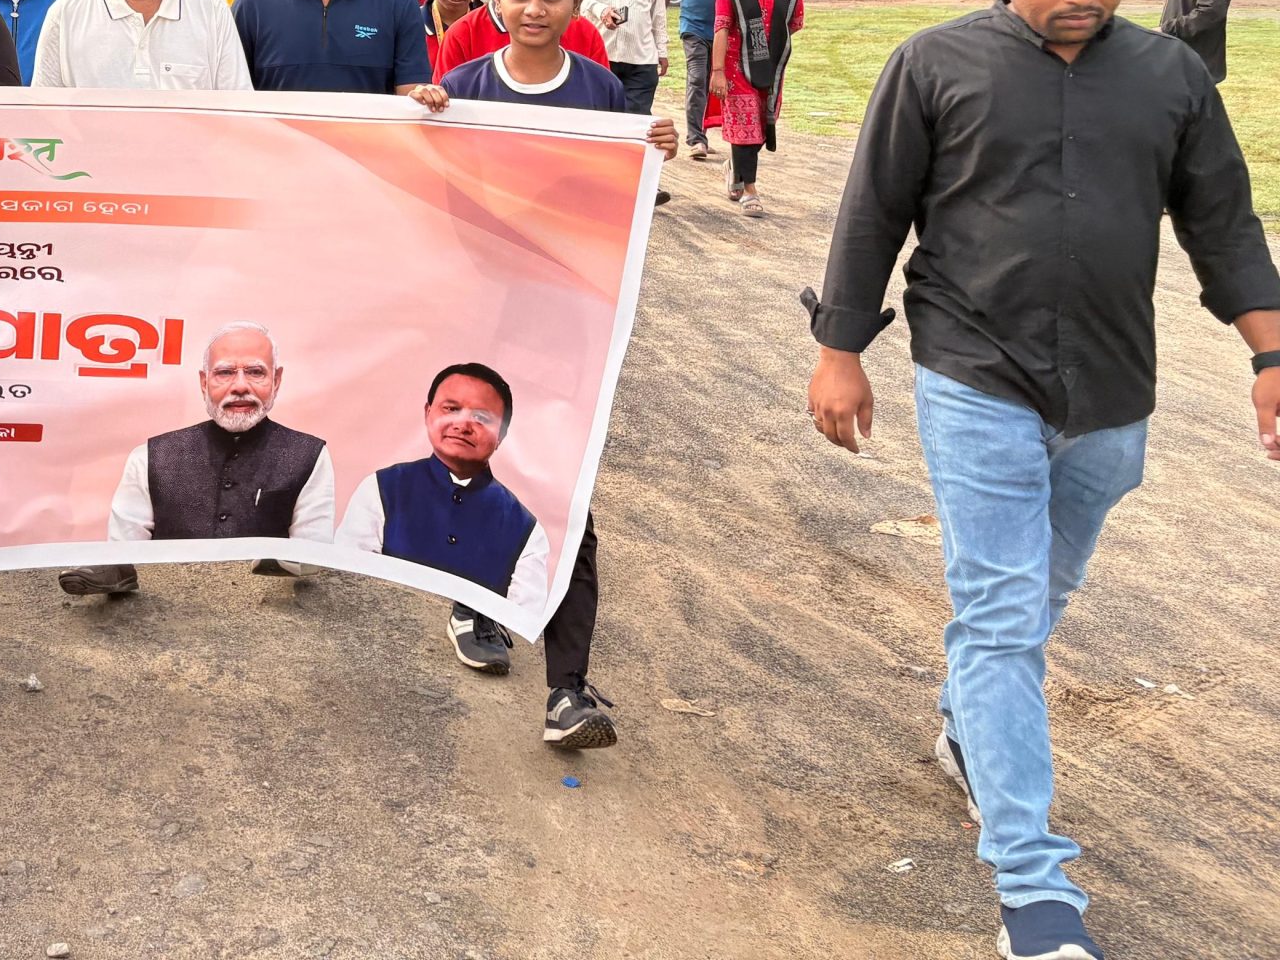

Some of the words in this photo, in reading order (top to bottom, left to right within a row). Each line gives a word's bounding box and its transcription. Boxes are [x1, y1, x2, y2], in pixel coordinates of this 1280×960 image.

[355, 25, 378, 33] Reebok
[0, 198, 74, 213] ସଜାଗ
[83, 200, 149, 216] ହେବା
